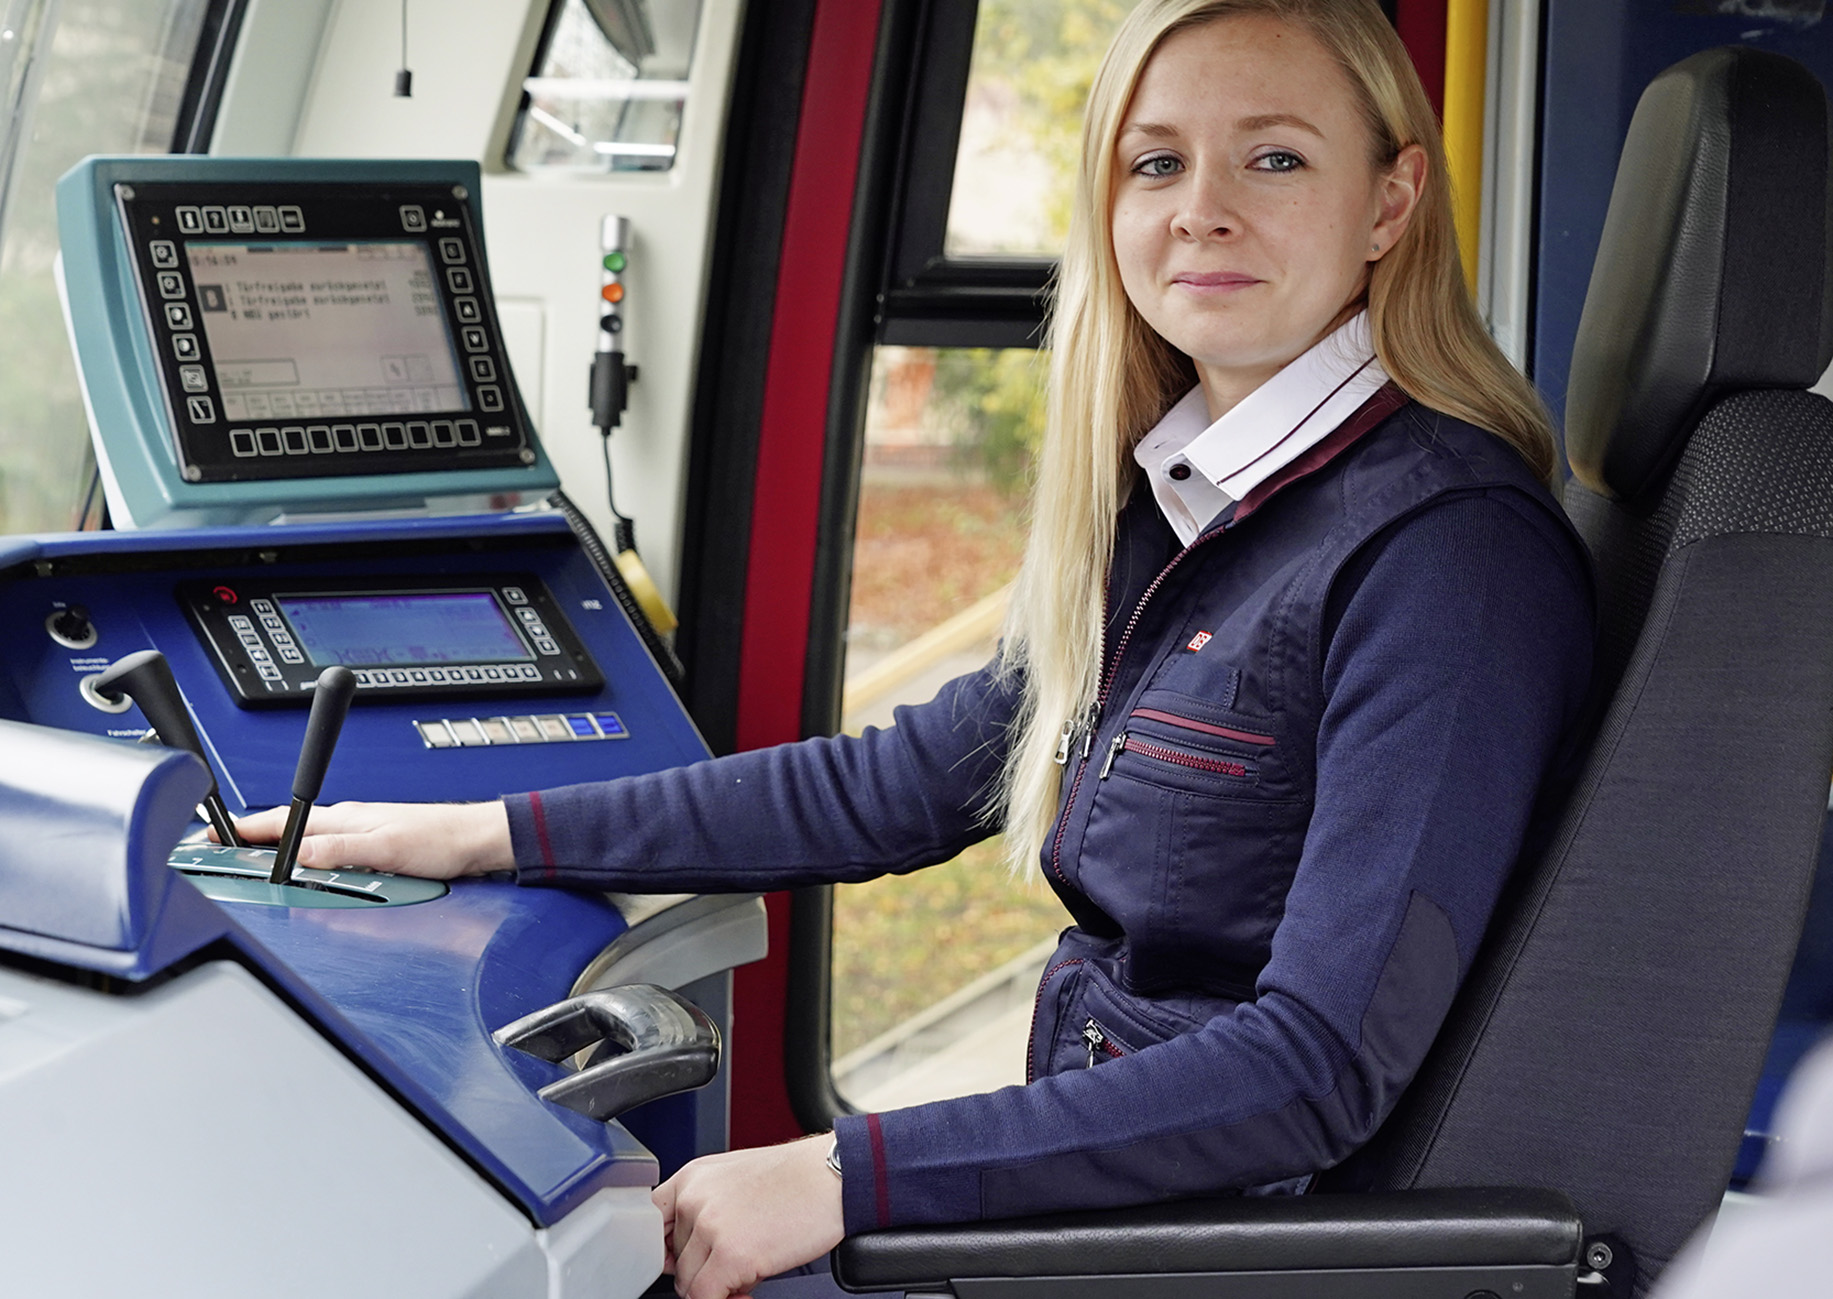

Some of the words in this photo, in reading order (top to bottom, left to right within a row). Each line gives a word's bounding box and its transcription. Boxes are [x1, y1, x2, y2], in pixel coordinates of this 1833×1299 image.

[237, 281, 303, 292] Türfreigabe
[240, 294, 306, 306] Türfreigabe
[1187, 630, 1213, 652] DB
